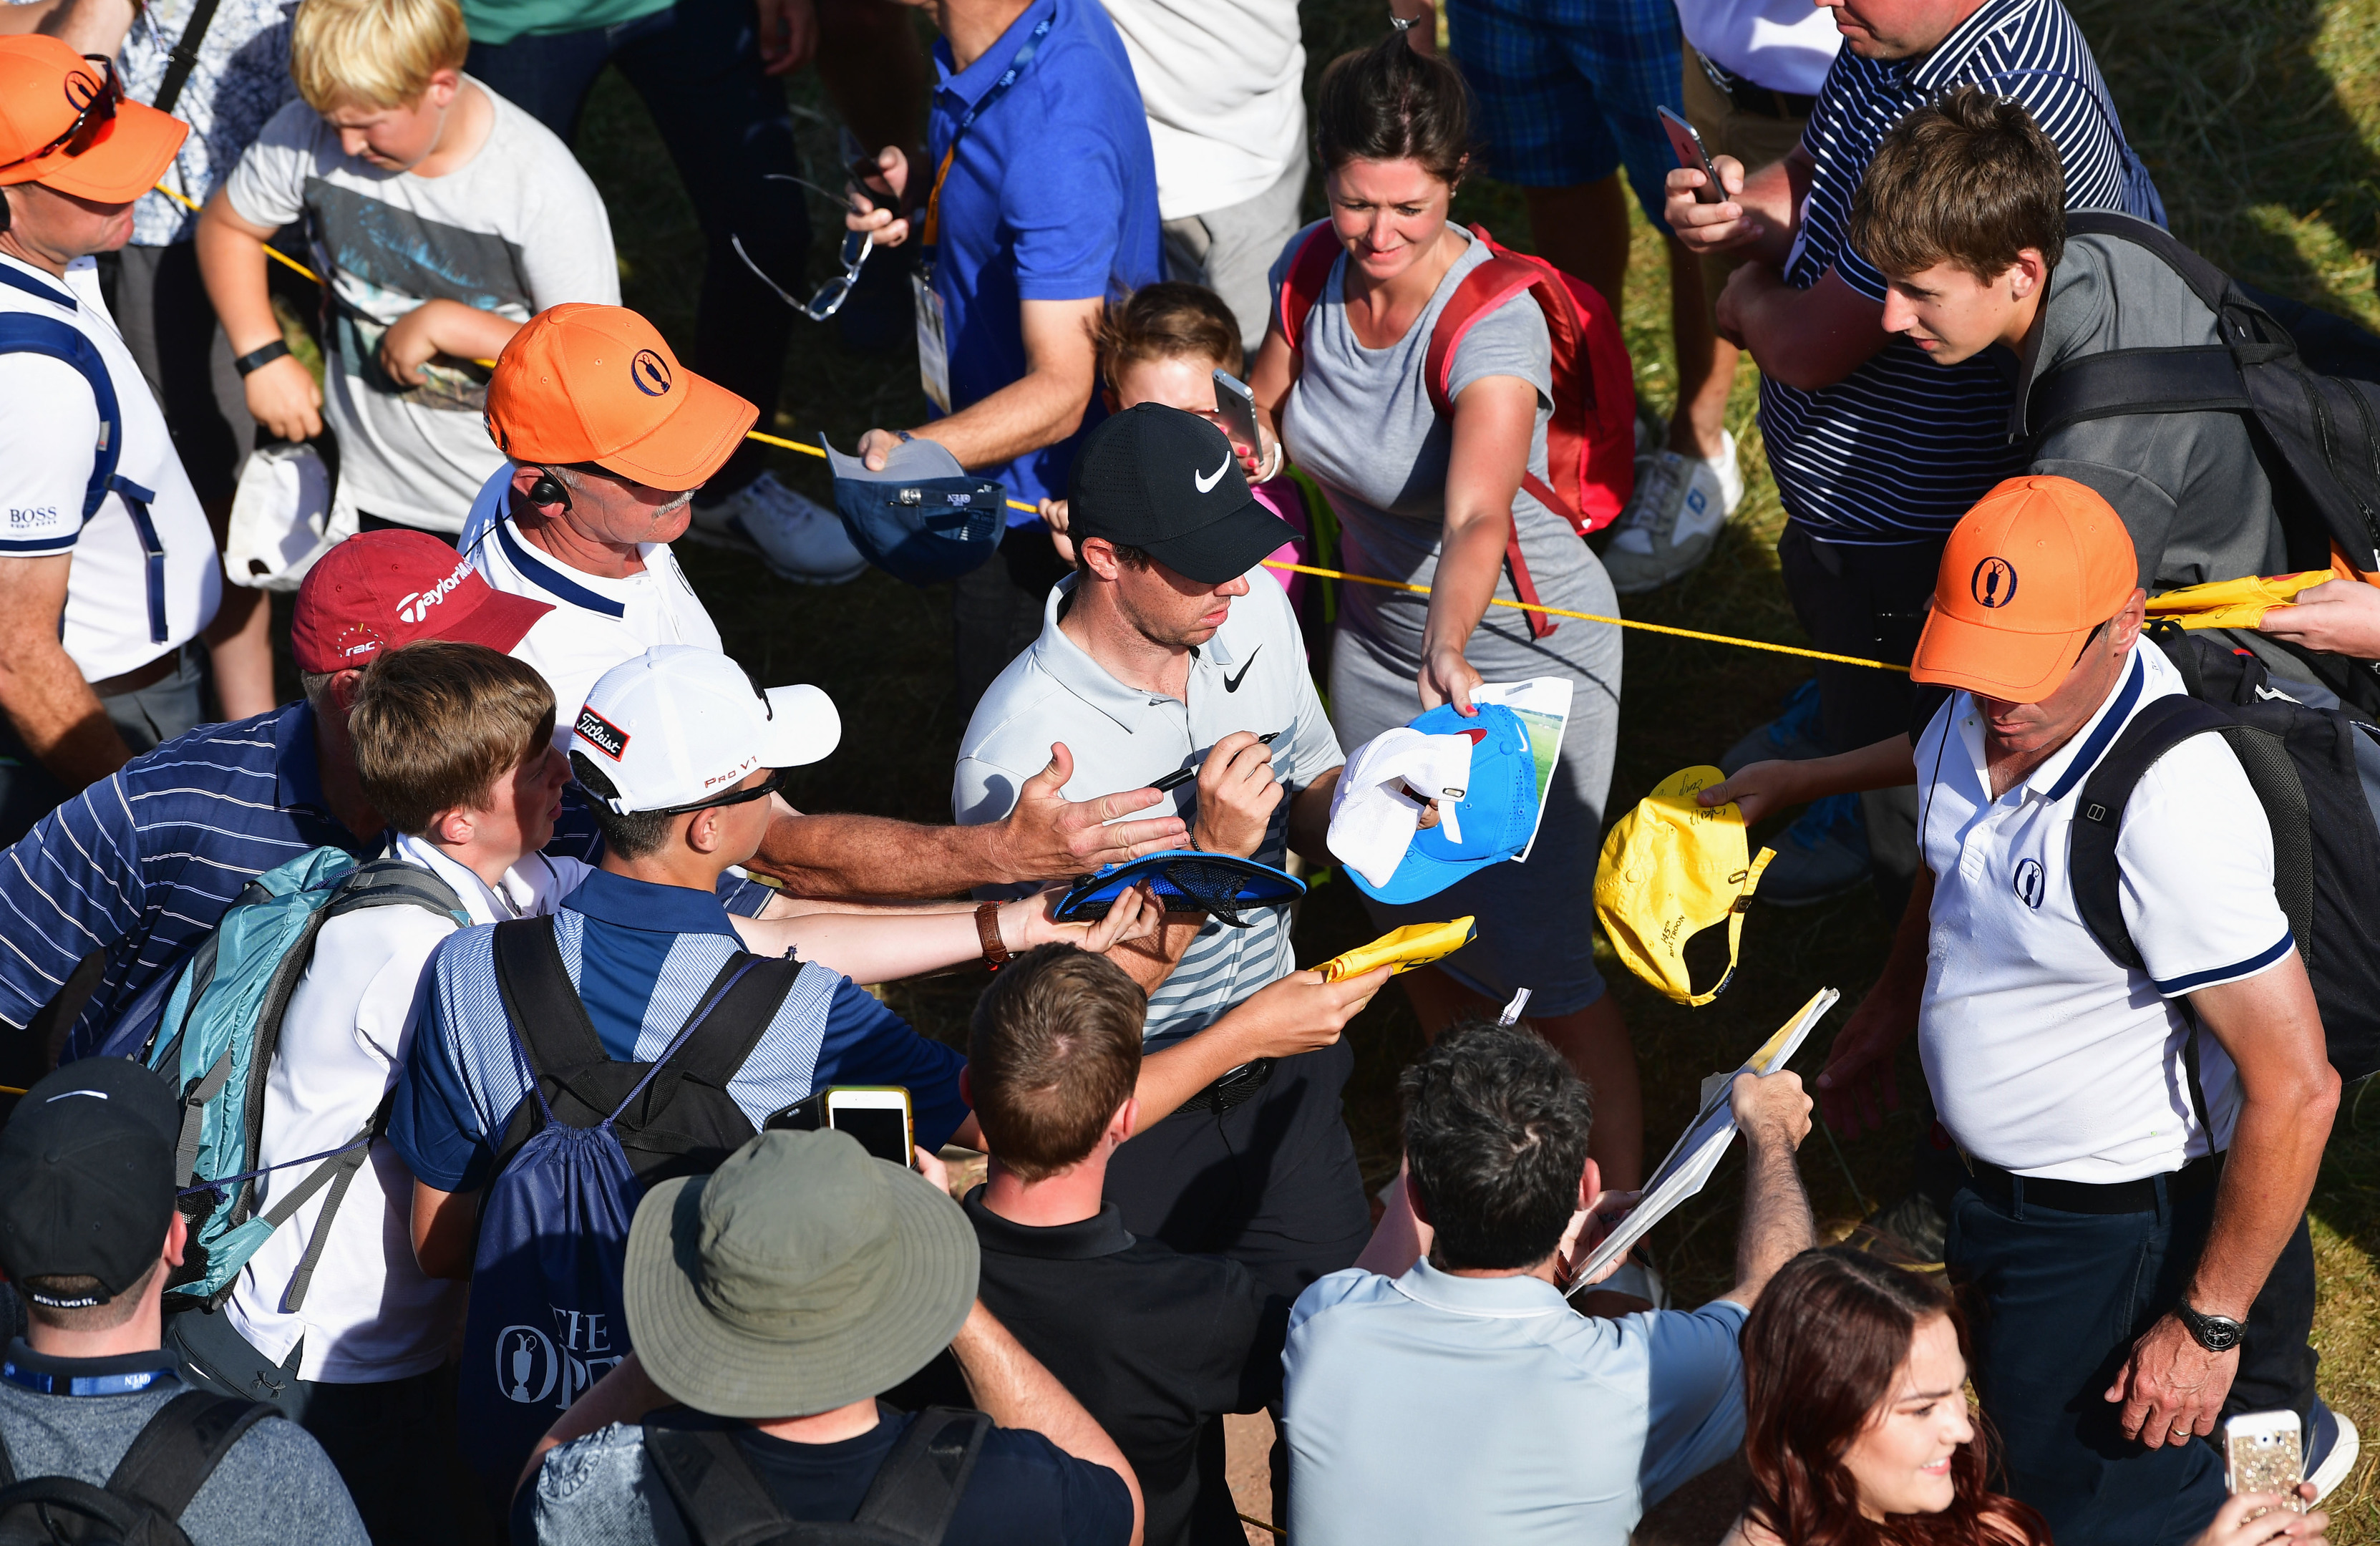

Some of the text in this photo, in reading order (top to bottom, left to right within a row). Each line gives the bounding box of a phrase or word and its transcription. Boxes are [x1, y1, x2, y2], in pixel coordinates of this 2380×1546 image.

[10, 506, 57, 522] BOSS
[396, 555, 475, 623] TaylorMa
[345, 641, 376, 657] rac
[576, 713, 621, 753] Titleist
[1671, 915, 1686, 940] TROON
[34, 1293, 59, 1307] JUST
